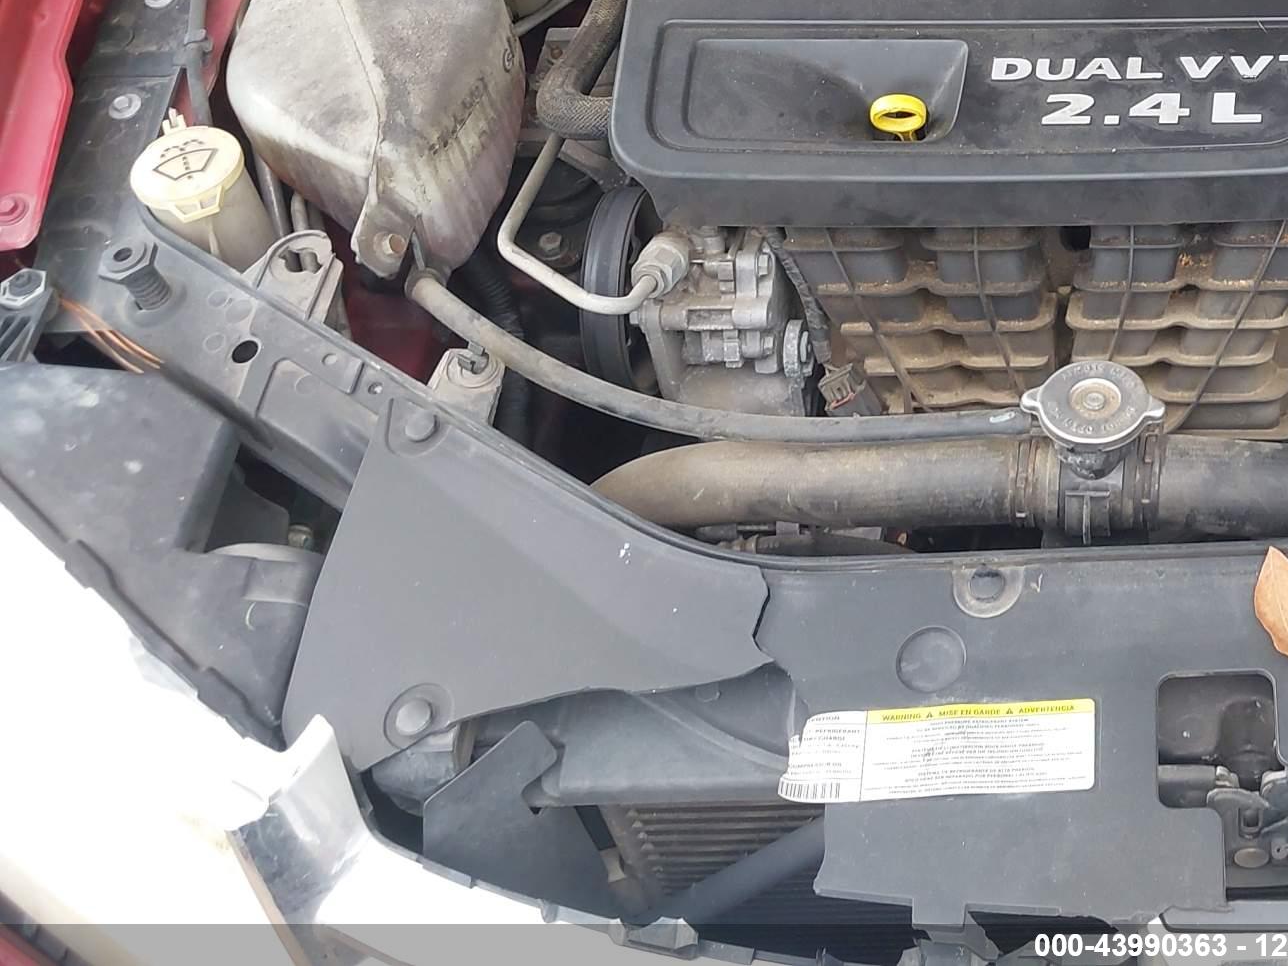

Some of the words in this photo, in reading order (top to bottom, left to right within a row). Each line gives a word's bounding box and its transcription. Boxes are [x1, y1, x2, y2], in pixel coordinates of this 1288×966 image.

[990, 56, 1164, 81] DUAL
[1041, 92, 1191, 125] 2.4
[1211, 91, 1262, 124] L
[882, 713, 921, 721] WARNING
